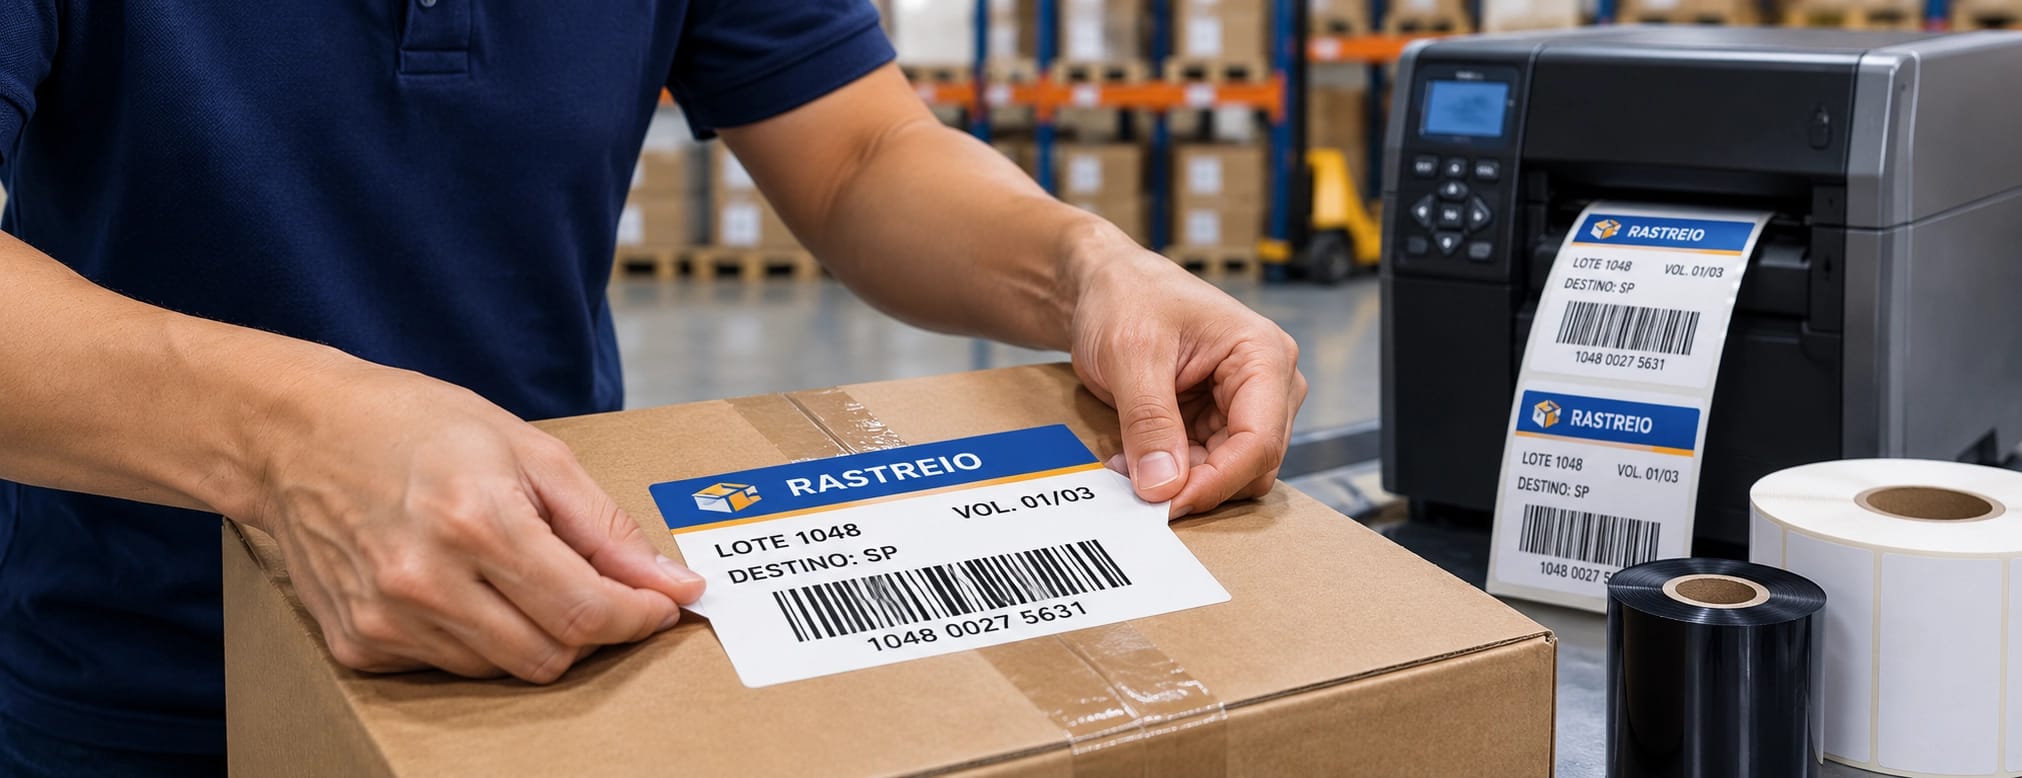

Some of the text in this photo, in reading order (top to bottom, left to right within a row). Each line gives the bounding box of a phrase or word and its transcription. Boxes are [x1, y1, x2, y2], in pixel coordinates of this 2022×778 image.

[1628, 225, 1705, 242] RASTREIO
[1573, 257, 1632, 272] LOTE 1048
[1665, 264, 1724, 278] VOL. 01/03
[1564, 278, 1635, 294] DESTINO: SP
[1575, 350, 1665, 370] 1048 0027 5631
[1570, 409, 1653, 434] RASTREIO
[1522, 451, 1583, 471] LOTE 1048
[786, 452, 982, 498] RASTREIO
[1617, 464, 1679, 484] VOL. 01/03
[1518, 476, 1590, 498] DESTINO: SP
[952, 486, 1096, 520] VOL. 01/03
[714, 522, 862, 559] LOTE 1048
[728, 544, 898, 585] DESTINO: SP
[1540, 561, 1567, 577] 1048
[1571, 568, 1600, 583] 0027
[868, 601, 1088, 652] 1048 0027 5631
